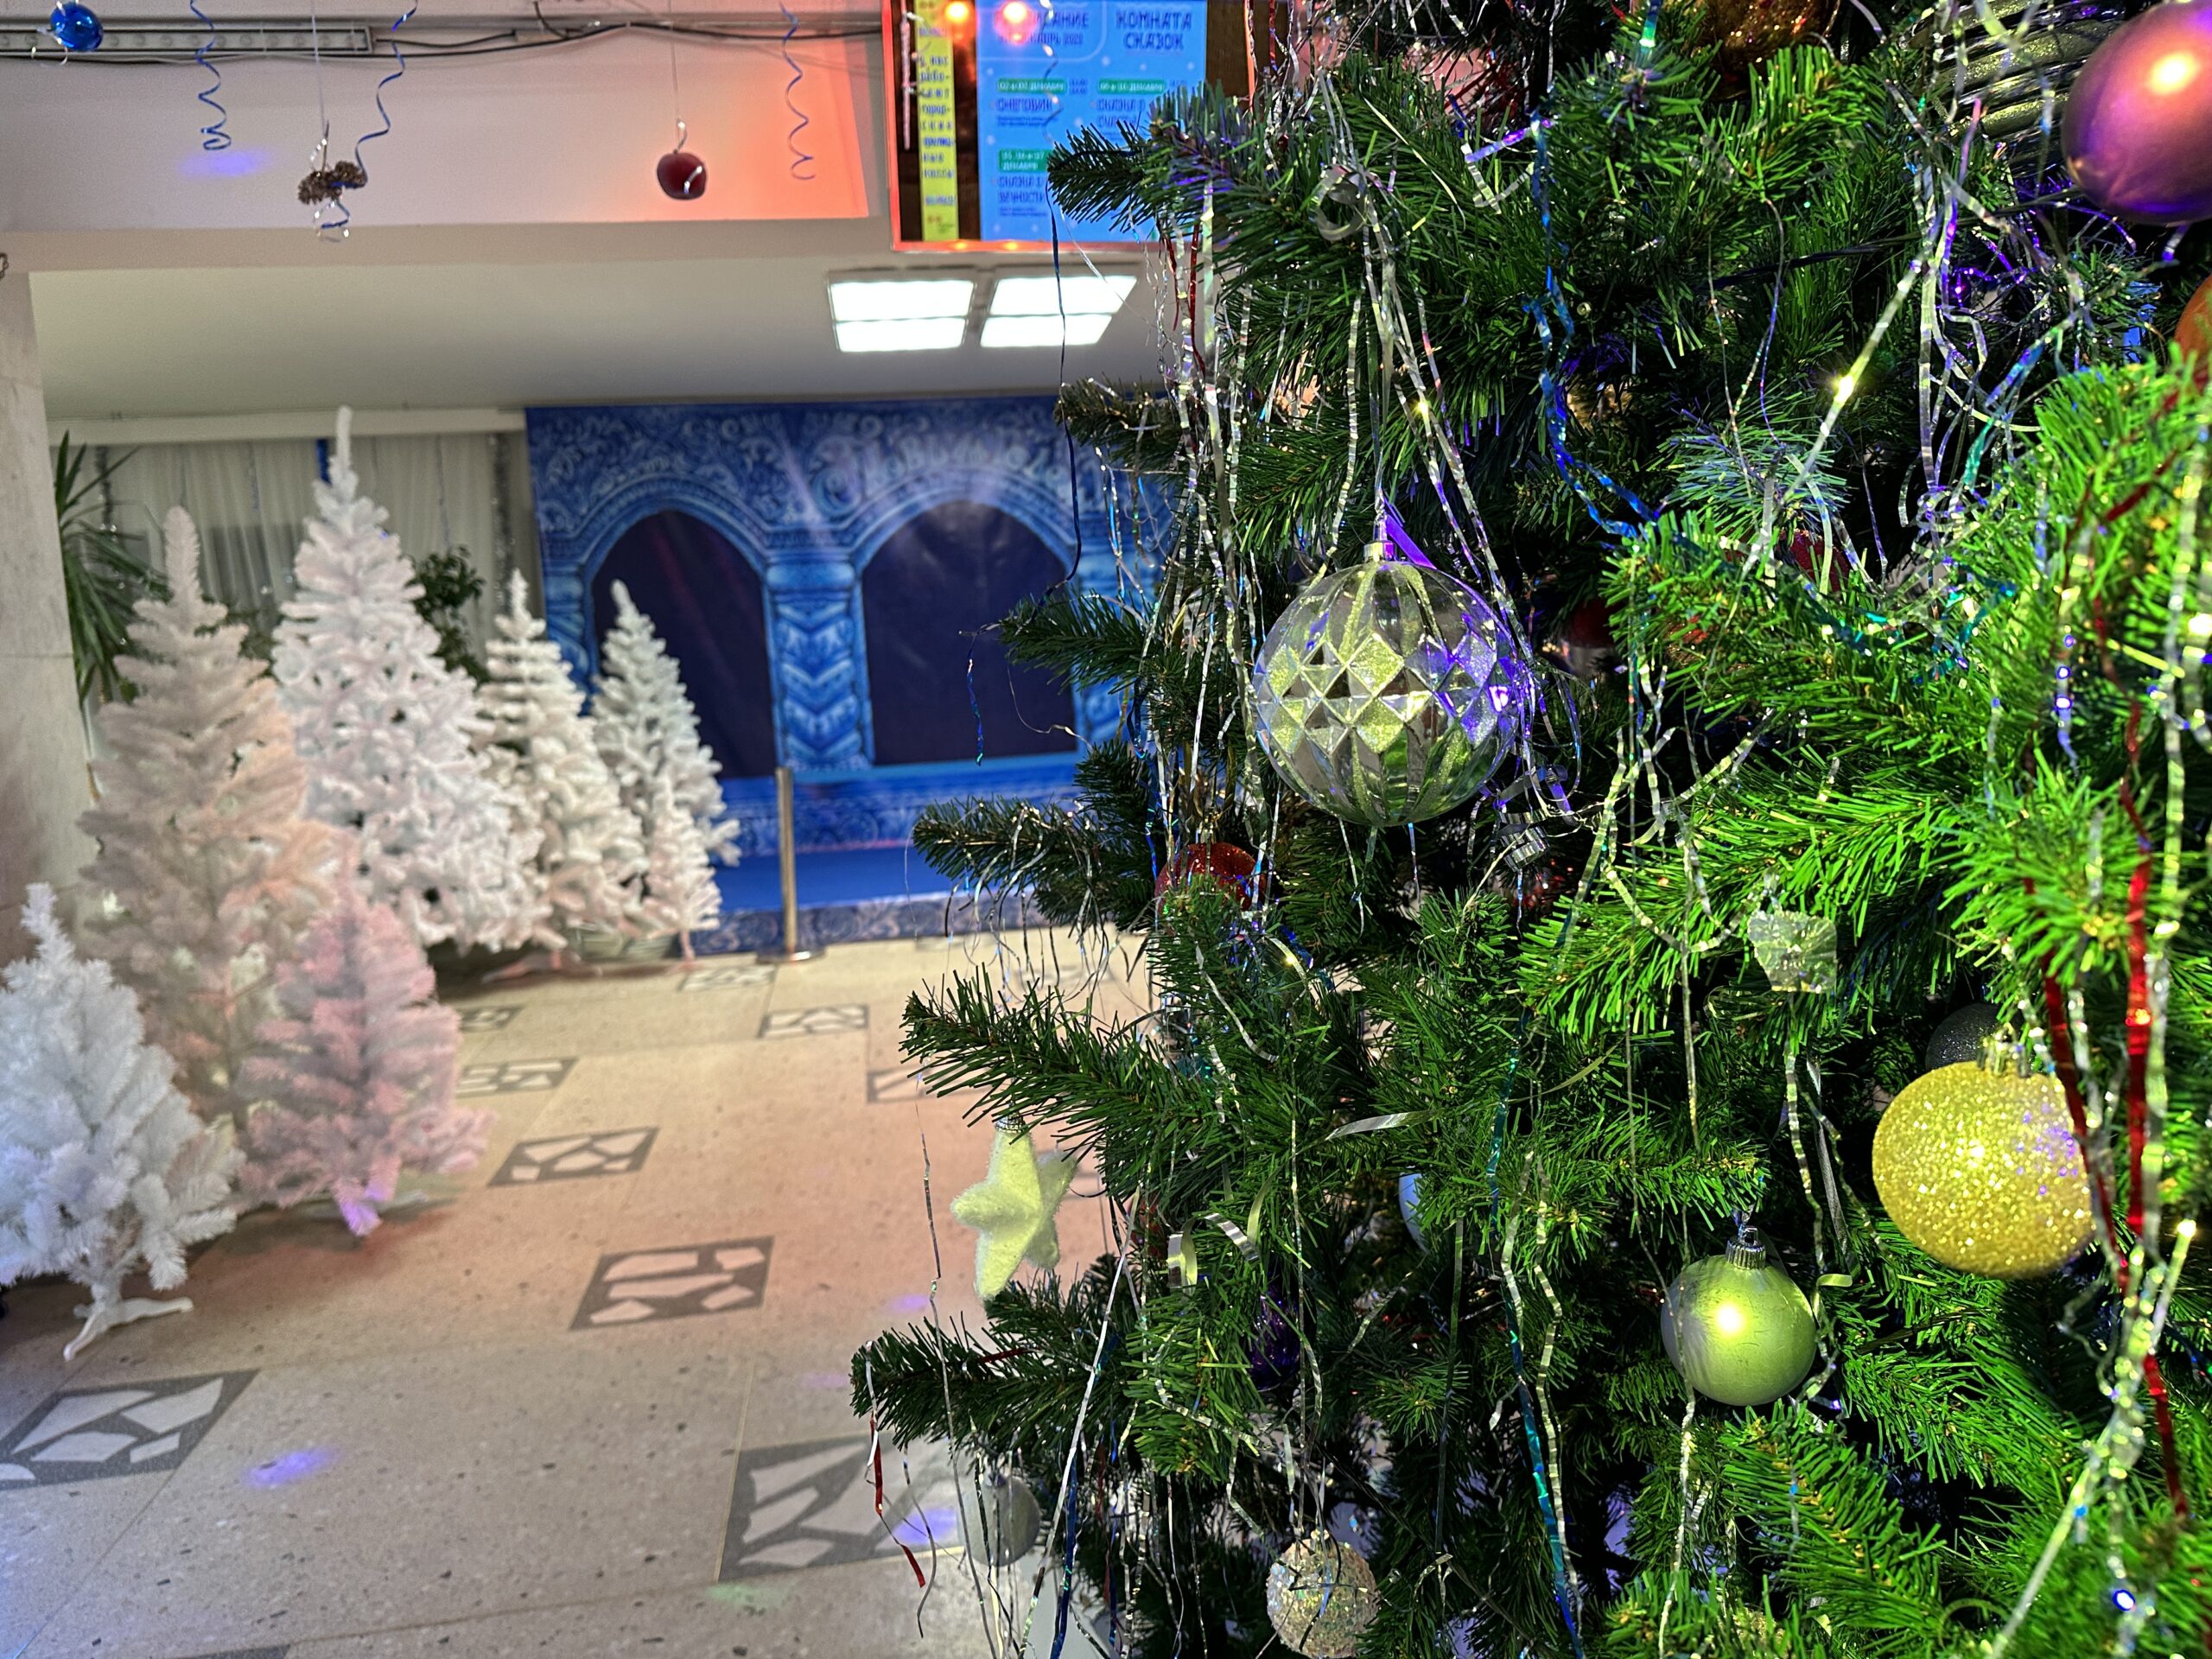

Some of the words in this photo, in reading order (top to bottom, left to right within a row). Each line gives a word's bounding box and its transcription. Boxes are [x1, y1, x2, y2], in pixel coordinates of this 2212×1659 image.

[1116, 11, 1192, 29] КОМНАТА
[1123, 32, 1185, 50] СКАЗОК
[998, 98, 1052, 111] СНЕГОВИК
[1096, 99, 1135, 111] СКАЗКА
[999, 175, 1034, 188] СКАЗКА
